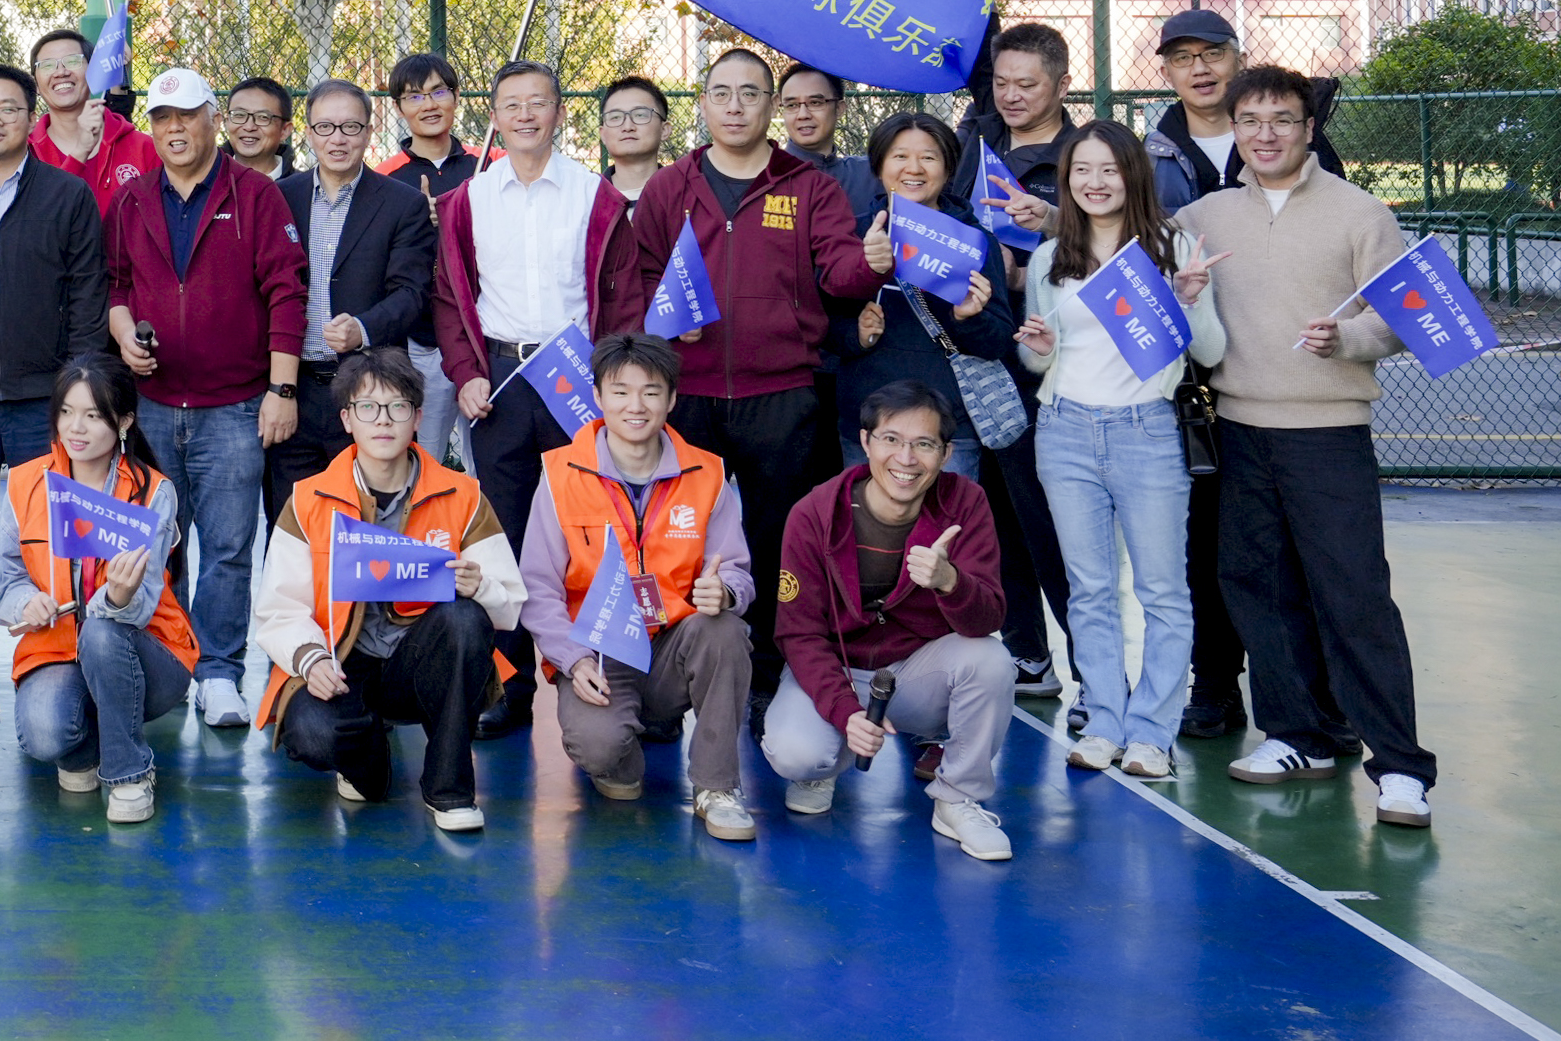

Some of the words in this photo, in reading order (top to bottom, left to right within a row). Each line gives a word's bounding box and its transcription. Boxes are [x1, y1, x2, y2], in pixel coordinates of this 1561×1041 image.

[763, 194, 798, 216] ME
[917, 253, 954, 280] ME
[654, 283, 676, 317] ME
[1115, 256, 1185, 349] 机械与动力工程学院
[1407, 250, 1484, 351] 机械与动力工程学院
[1124, 316, 1157, 350] ME
[1416, 312, 1452, 347] ME
[566, 394, 597, 426] ME
[50, 490, 152, 537] 机械与动力工程学院
[669, 506, 696, 530] ME
[98, 527, 131, 553] ME
[355, 561, 362, 579] I
[396, 562, 430, 580] ME
